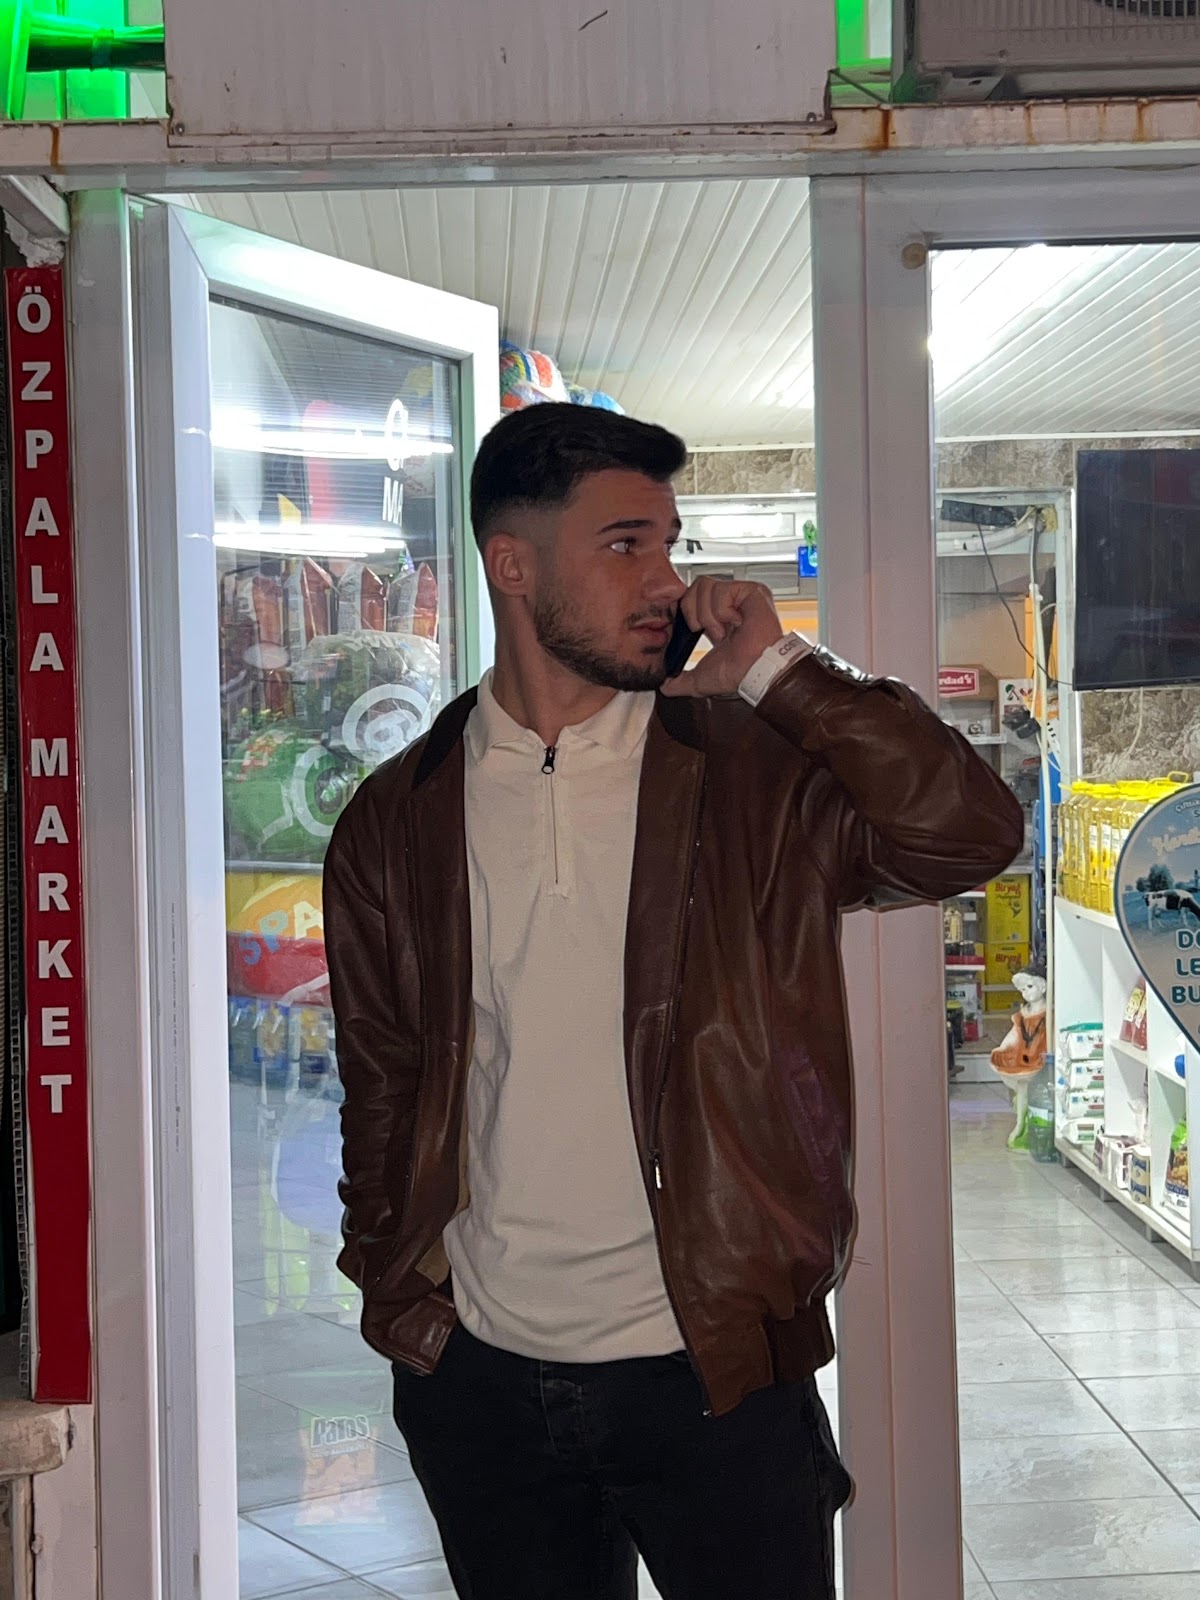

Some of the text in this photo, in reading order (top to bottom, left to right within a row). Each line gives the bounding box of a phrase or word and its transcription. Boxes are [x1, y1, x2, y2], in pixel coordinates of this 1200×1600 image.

[17, 286, 73, 1114] ÖZPALA MARKET
[1177, 930, 1200, 949] D
